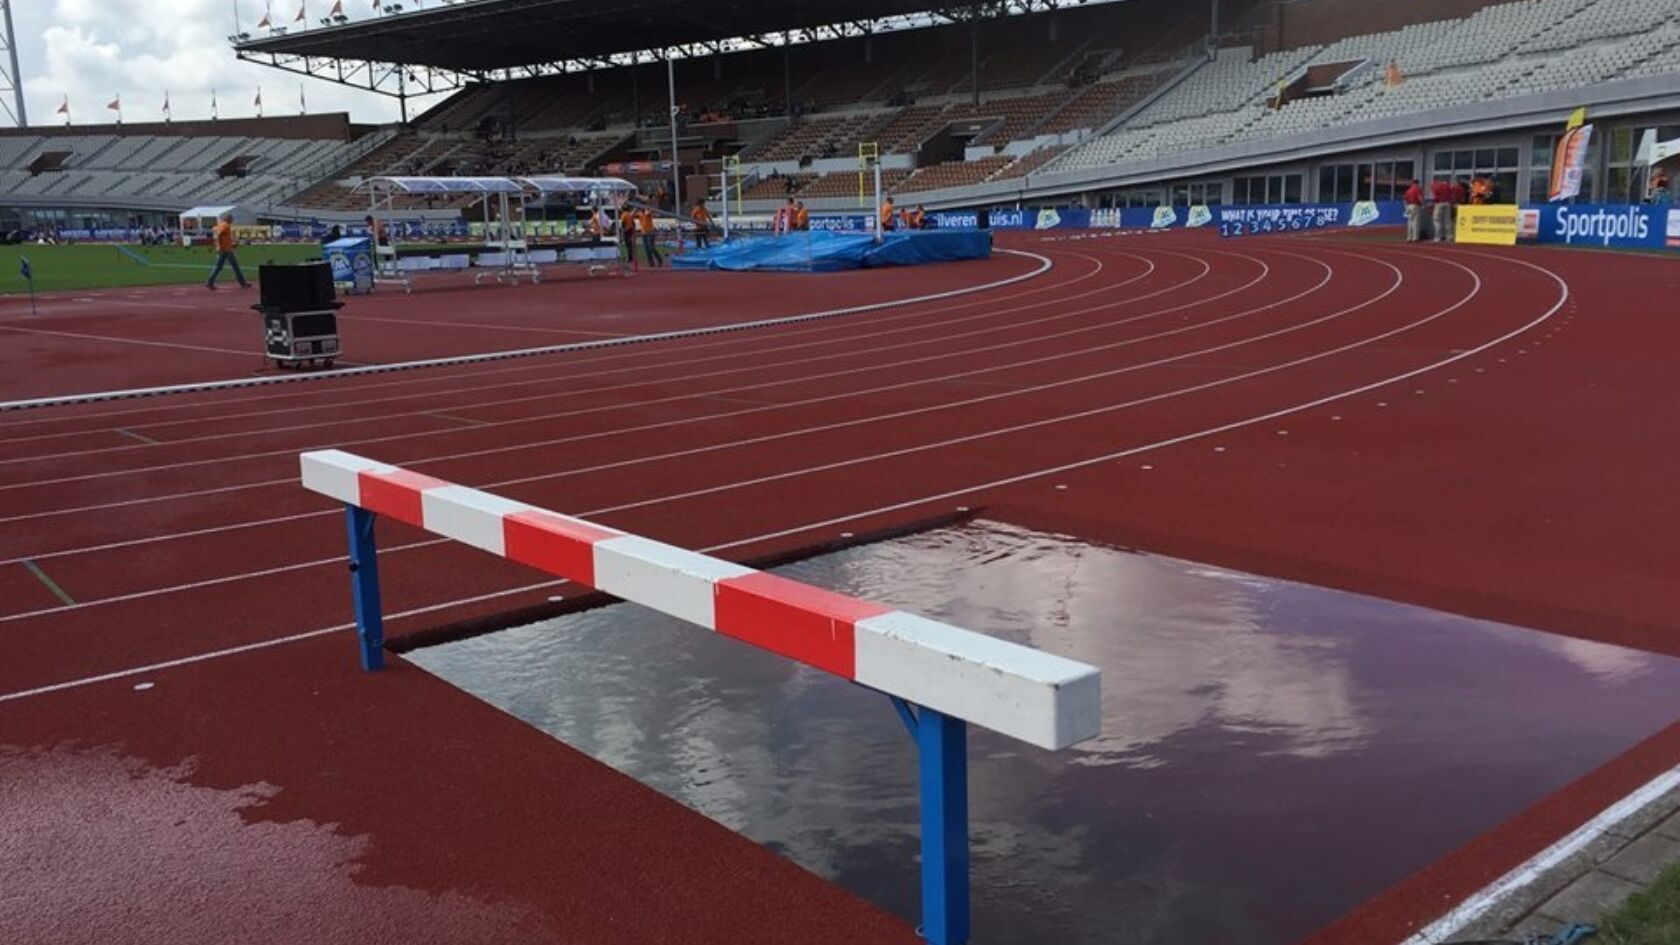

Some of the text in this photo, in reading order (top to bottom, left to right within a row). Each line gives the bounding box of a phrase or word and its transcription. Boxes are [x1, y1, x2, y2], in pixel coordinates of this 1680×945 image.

[934, 211, 1023, 227] ilveren uis.nl
[1555, 206, 1648, 246] Sportpolis
[1223, 224, 1228, 236] 1
[1234, 223, 1242, 235] 2
[1251, 222, 1259, 233] 3
